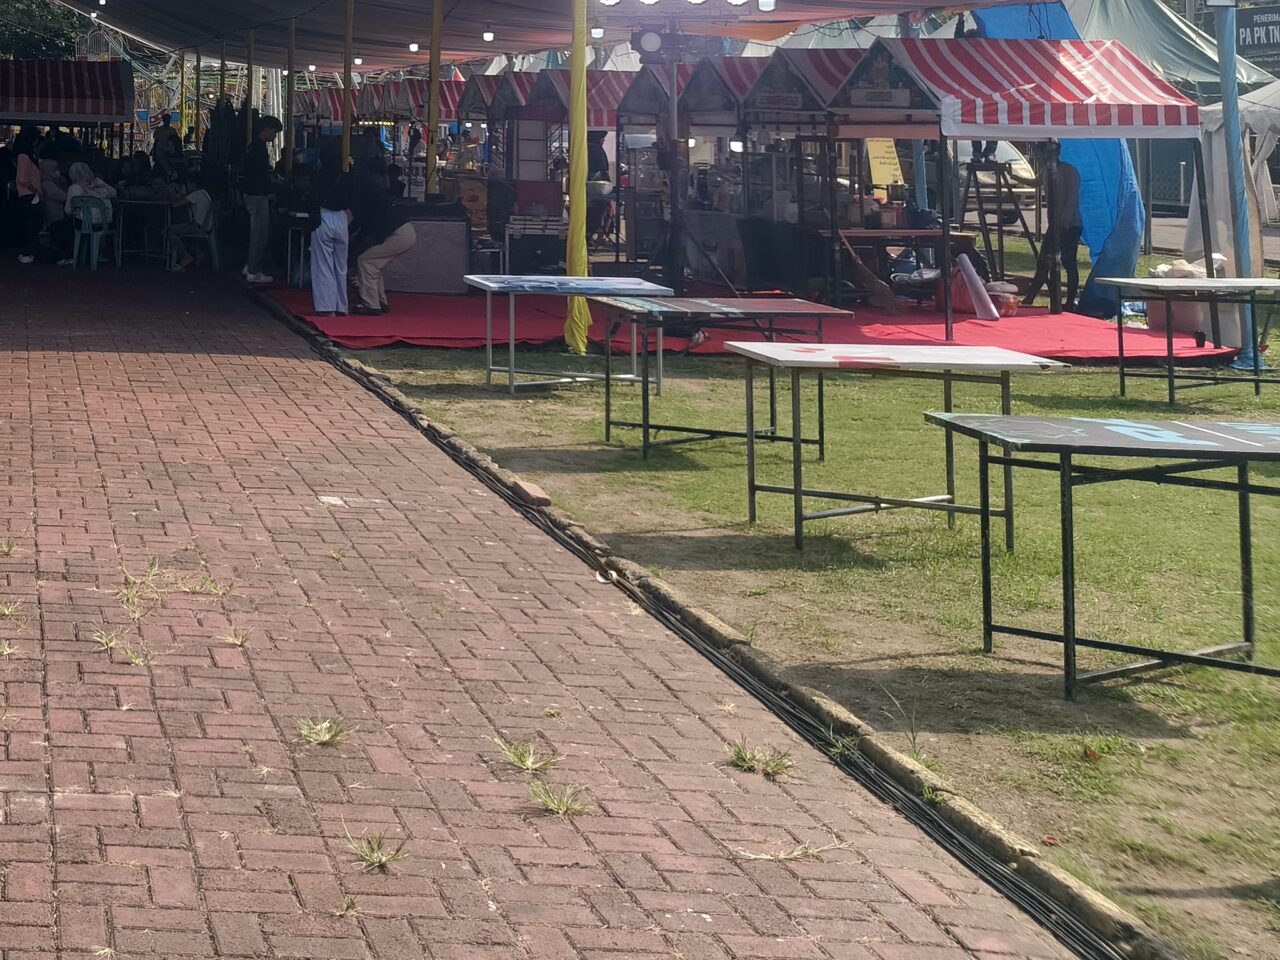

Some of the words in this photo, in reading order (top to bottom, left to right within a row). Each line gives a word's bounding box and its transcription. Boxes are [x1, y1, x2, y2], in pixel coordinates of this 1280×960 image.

[1253, 13, 1280, 23] PENERIM
[1239, 27, 1252, 45] PA
[1253, 26, 1267, 45] PK
